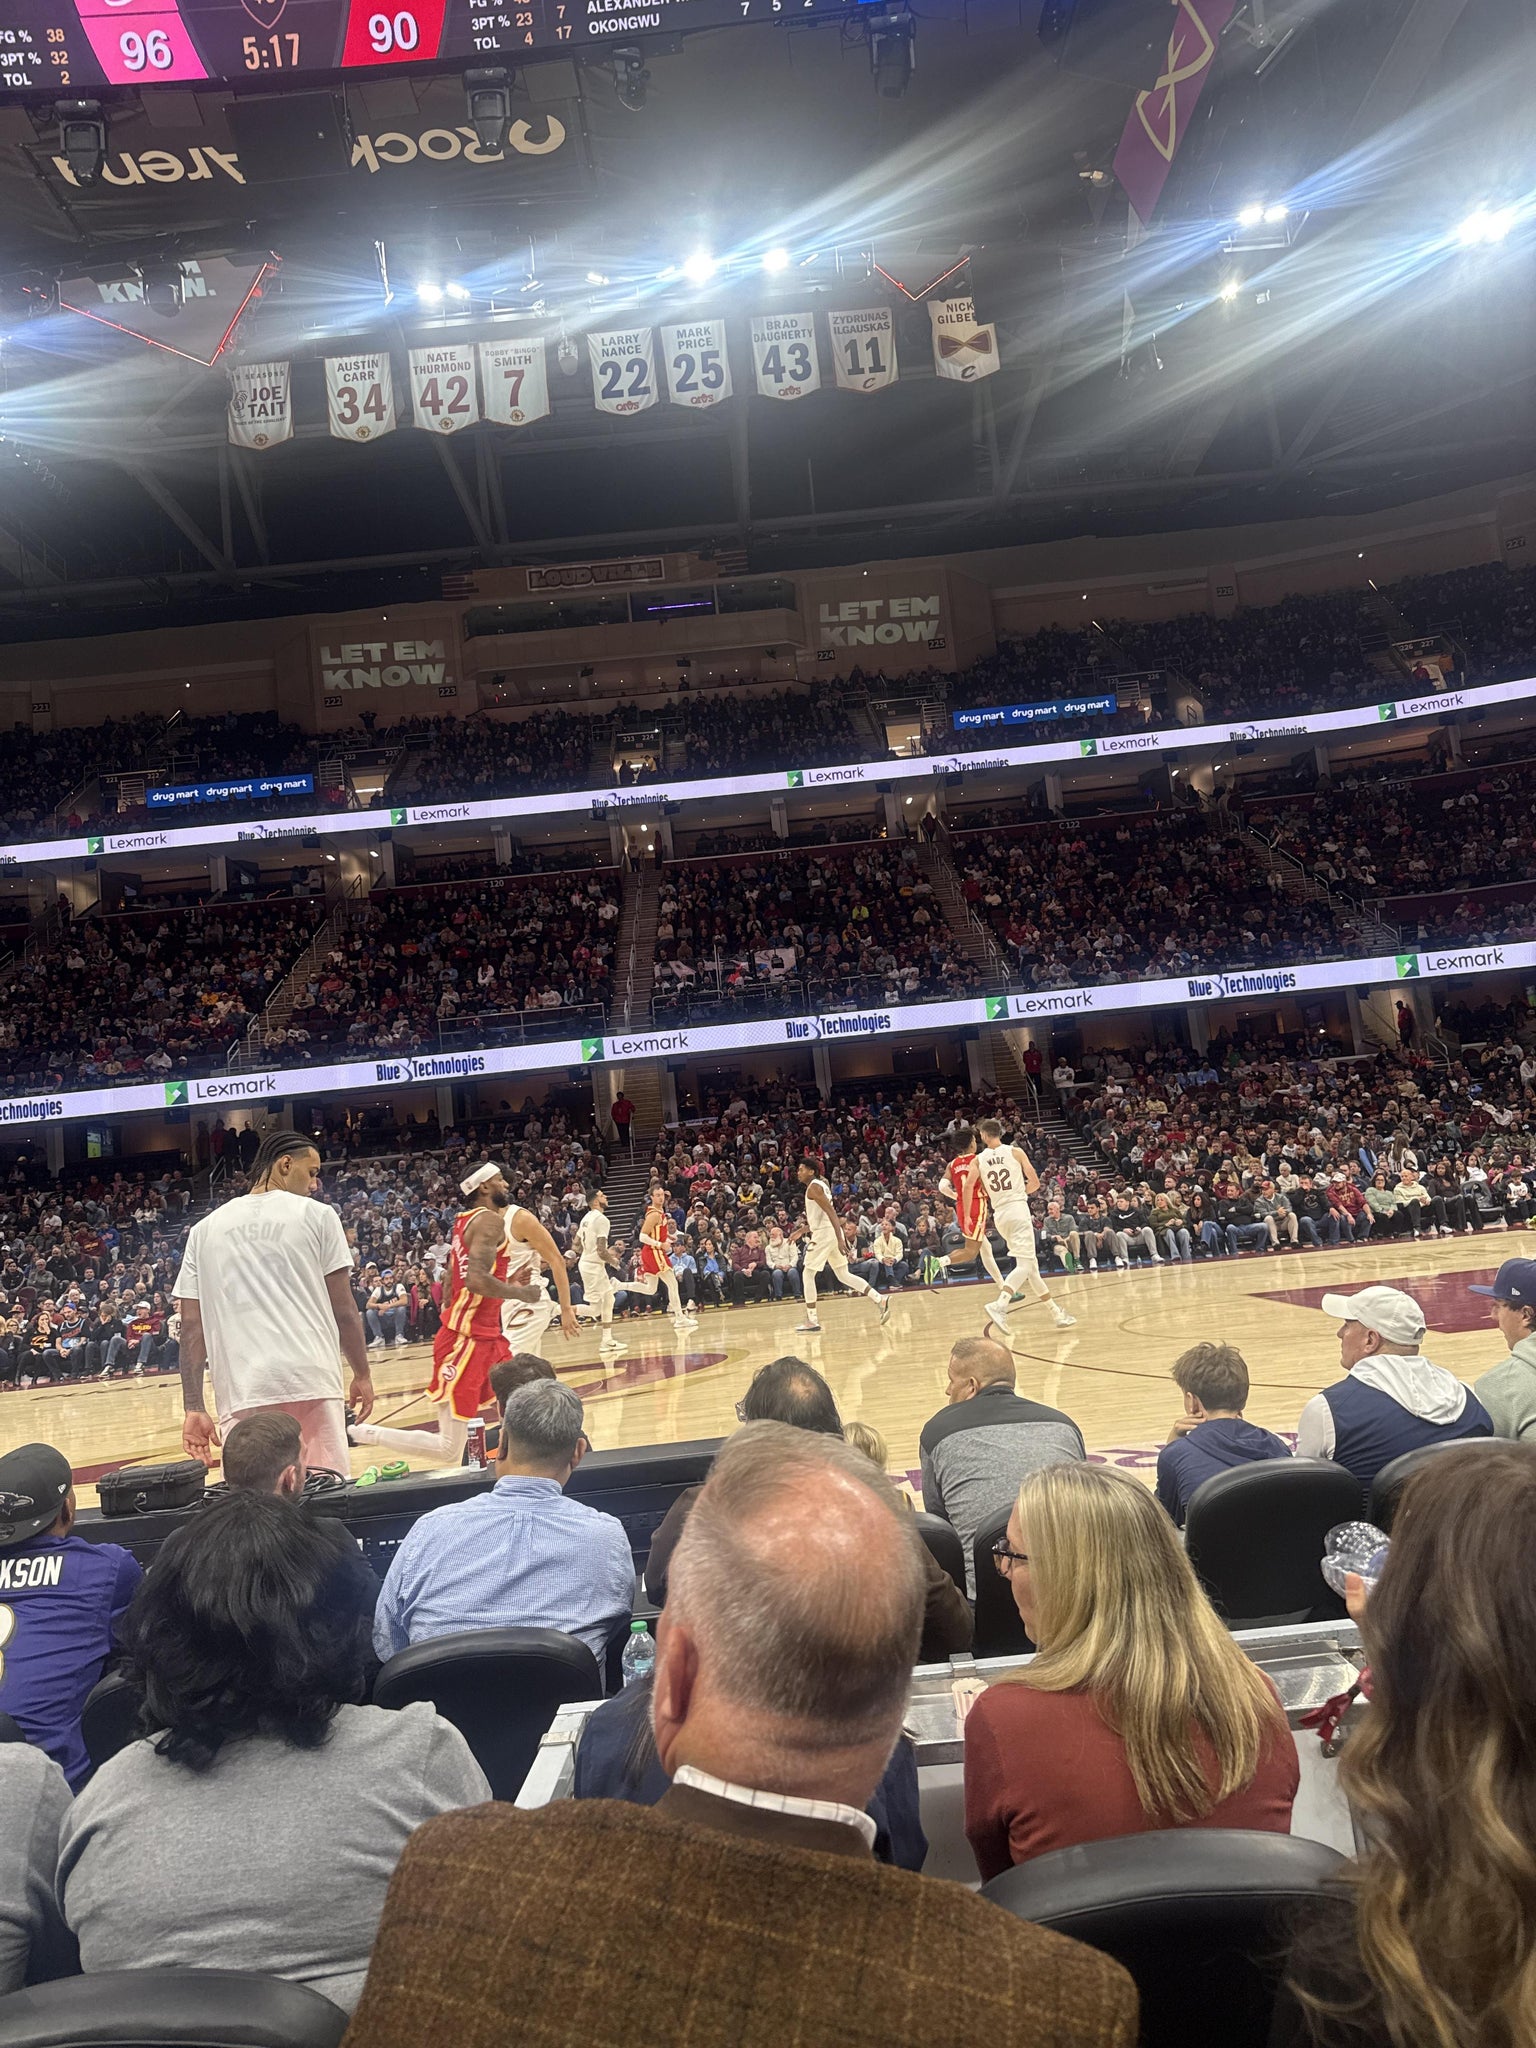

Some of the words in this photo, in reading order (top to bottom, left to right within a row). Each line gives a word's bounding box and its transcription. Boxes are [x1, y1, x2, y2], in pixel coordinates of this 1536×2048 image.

[557, 5, 566, 19] 7
[741, 2, 750, 15] 7
[471, 16, 495, 31] 3PT
[498, 15, 511, 28] %
[516, 12, 533, 27] 23
[556, 26, 572, 40] 17
[588, 13, 660, 35] OKONGWU
[18, 31, 32, 42] %
[47, 29, 65, 42] 38
[368, 11, 419, 53] 90
[474, 36, 500, 51] TOL
[524, 32, 533, 46] 4
[0, 53, 25, 66] 3PT
[28, 52, 42, 65] %
[51, 51, 69, 65] 32
[119, 30, 173, 71] 96
[242, 33, 300, 71] 5:17
[3, 73, 32, 86] TOL
[60, 71, 71, 85] 2
[946, 302, 974, 313] NICK
[766, 319, 798, 331] BRAD
[832, 312, 888, 325] ZYDRUNAS
[937, 312, 977, 325] GILBE
[676, 326, 712, 340] MARK
[753, 328, 814, 343] DAUGHERTY
[833, 321, 890, 335] ILGAUSKAS
[601, 333, 640, 347] LARRY
[677, 337, 714, 350] PRICE
[427, 351, 457, 363] NATE
[601, 345, 642, 358] NANCE
[844, 337, 887, 376] 11
[337, 359, 379, 373] AUSTIN
[412, 361, 472, 376] THURMOND
[494, 355, 532, 367] SMITH
[761, 342, 812, 384] 43
[245, 370, 285, 380] SEASONS
[343, 371, 375, 383] CARR
[600, 358, 651, 399] 22
[673, 350, 724, 393] 25
[250, 386, 282, 401] JOE
[419, 375, 471, 416] 42
[504, 369, 525, 408] 7
[247, 402, 286, 418] TAIT
[336, 383, 387, 425] 34
[820, 600, 883, 623] LET
[889, 596, 940, 618] EM
[320, 642, 387, 665] LET
[393, 640, 446, 661] EM
[322, 663, 453, 690] KNOW.
[959, 714, 981, 724] drug
[982, 711, 1005, 721] mart
[1012, 708, 1034, 718] drug
[1034, 705, 1057, 715] mart
[1064, 702, 1086, 712] drug
[1087, 699, 1110, 709] mart
[1402, 694, 1463, 715] Lexmark
[1102, 734, 1159, 751] Lexmark
[808, 766, 865, 783] Lexmark
[152, 791, 175, 802] drug
[176, 789, 199, 800] mart
[206, 786, 229, 797] drug
[229, 784, 252, 795] mart
[283, 779, 307, 790] mart
[412, 805, 470, 821] Lexmark
[110, 833, 167, 850] Lexmark
[1188, 979, 1212, 998] Blue
[1223, 972, 1296, 994] Technologies
[1426, 951, 1504, 972] Lexmark
[786, 1021, 809, 1039] Blue
[821, 1013, 891, 1035] Technologies
[1016, 992, 1093, 1014] Lexmark
[376, 1063, 400, 1081] Blue
[412, 1055, 485, 1078] Technologies
[612, 1033, 688, 1055] Lexmark
[0, 1098, 62, 1121] echnologies
[196, 1077, 276, 1099] Lexmark
[987, 1157, 1004, 1166] WADE
[987, 1168, 1012, 1192] 32
[225, 1222, 286, 1243] TYSON
